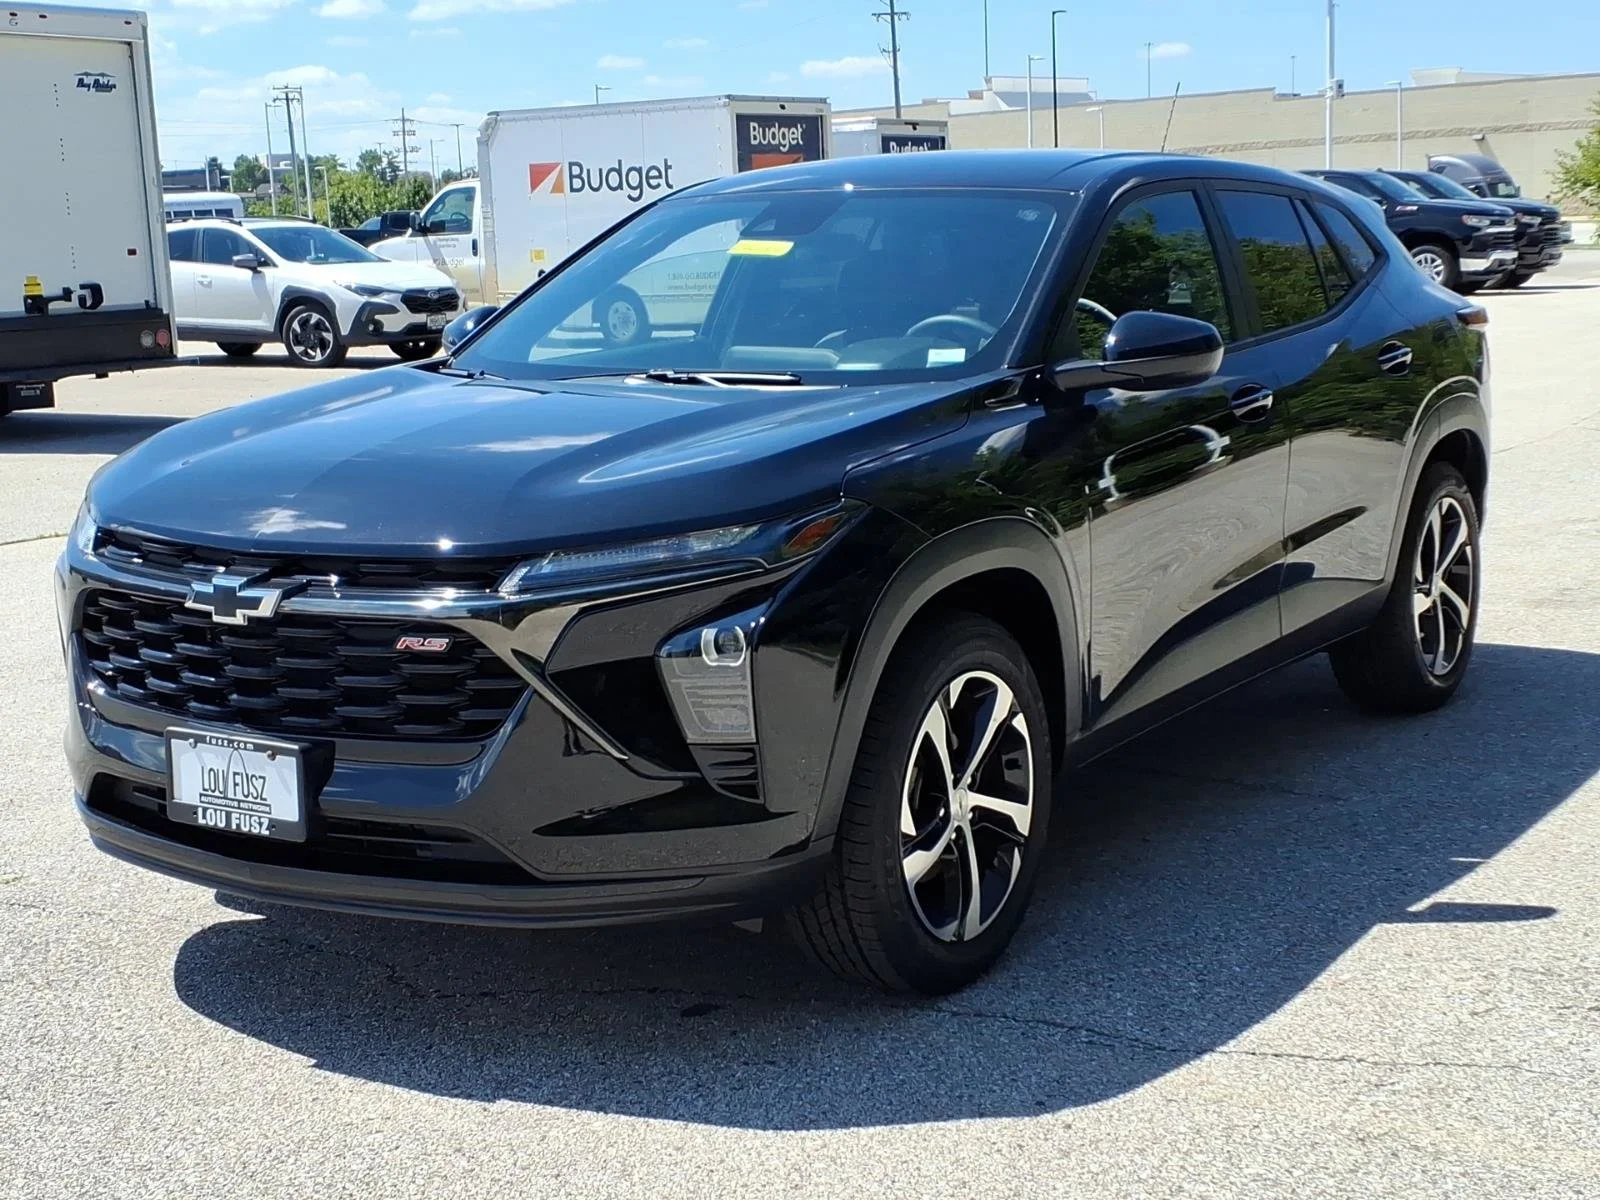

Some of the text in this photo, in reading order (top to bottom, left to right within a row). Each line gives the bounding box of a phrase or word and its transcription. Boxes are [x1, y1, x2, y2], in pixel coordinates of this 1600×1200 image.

[749, 121, 804, 152] Budget
[568, 158, 674, 202] Budget
[396, 637, 449, 650] RS
[206, 735, 254, 750] fusz.com
[201, 765, 268, 801] LOU FUSZ
[201, 795, 271, 813] AUTOMOTIVE NETWORK
[197, 807, 270, 835] LOU FUSZ
